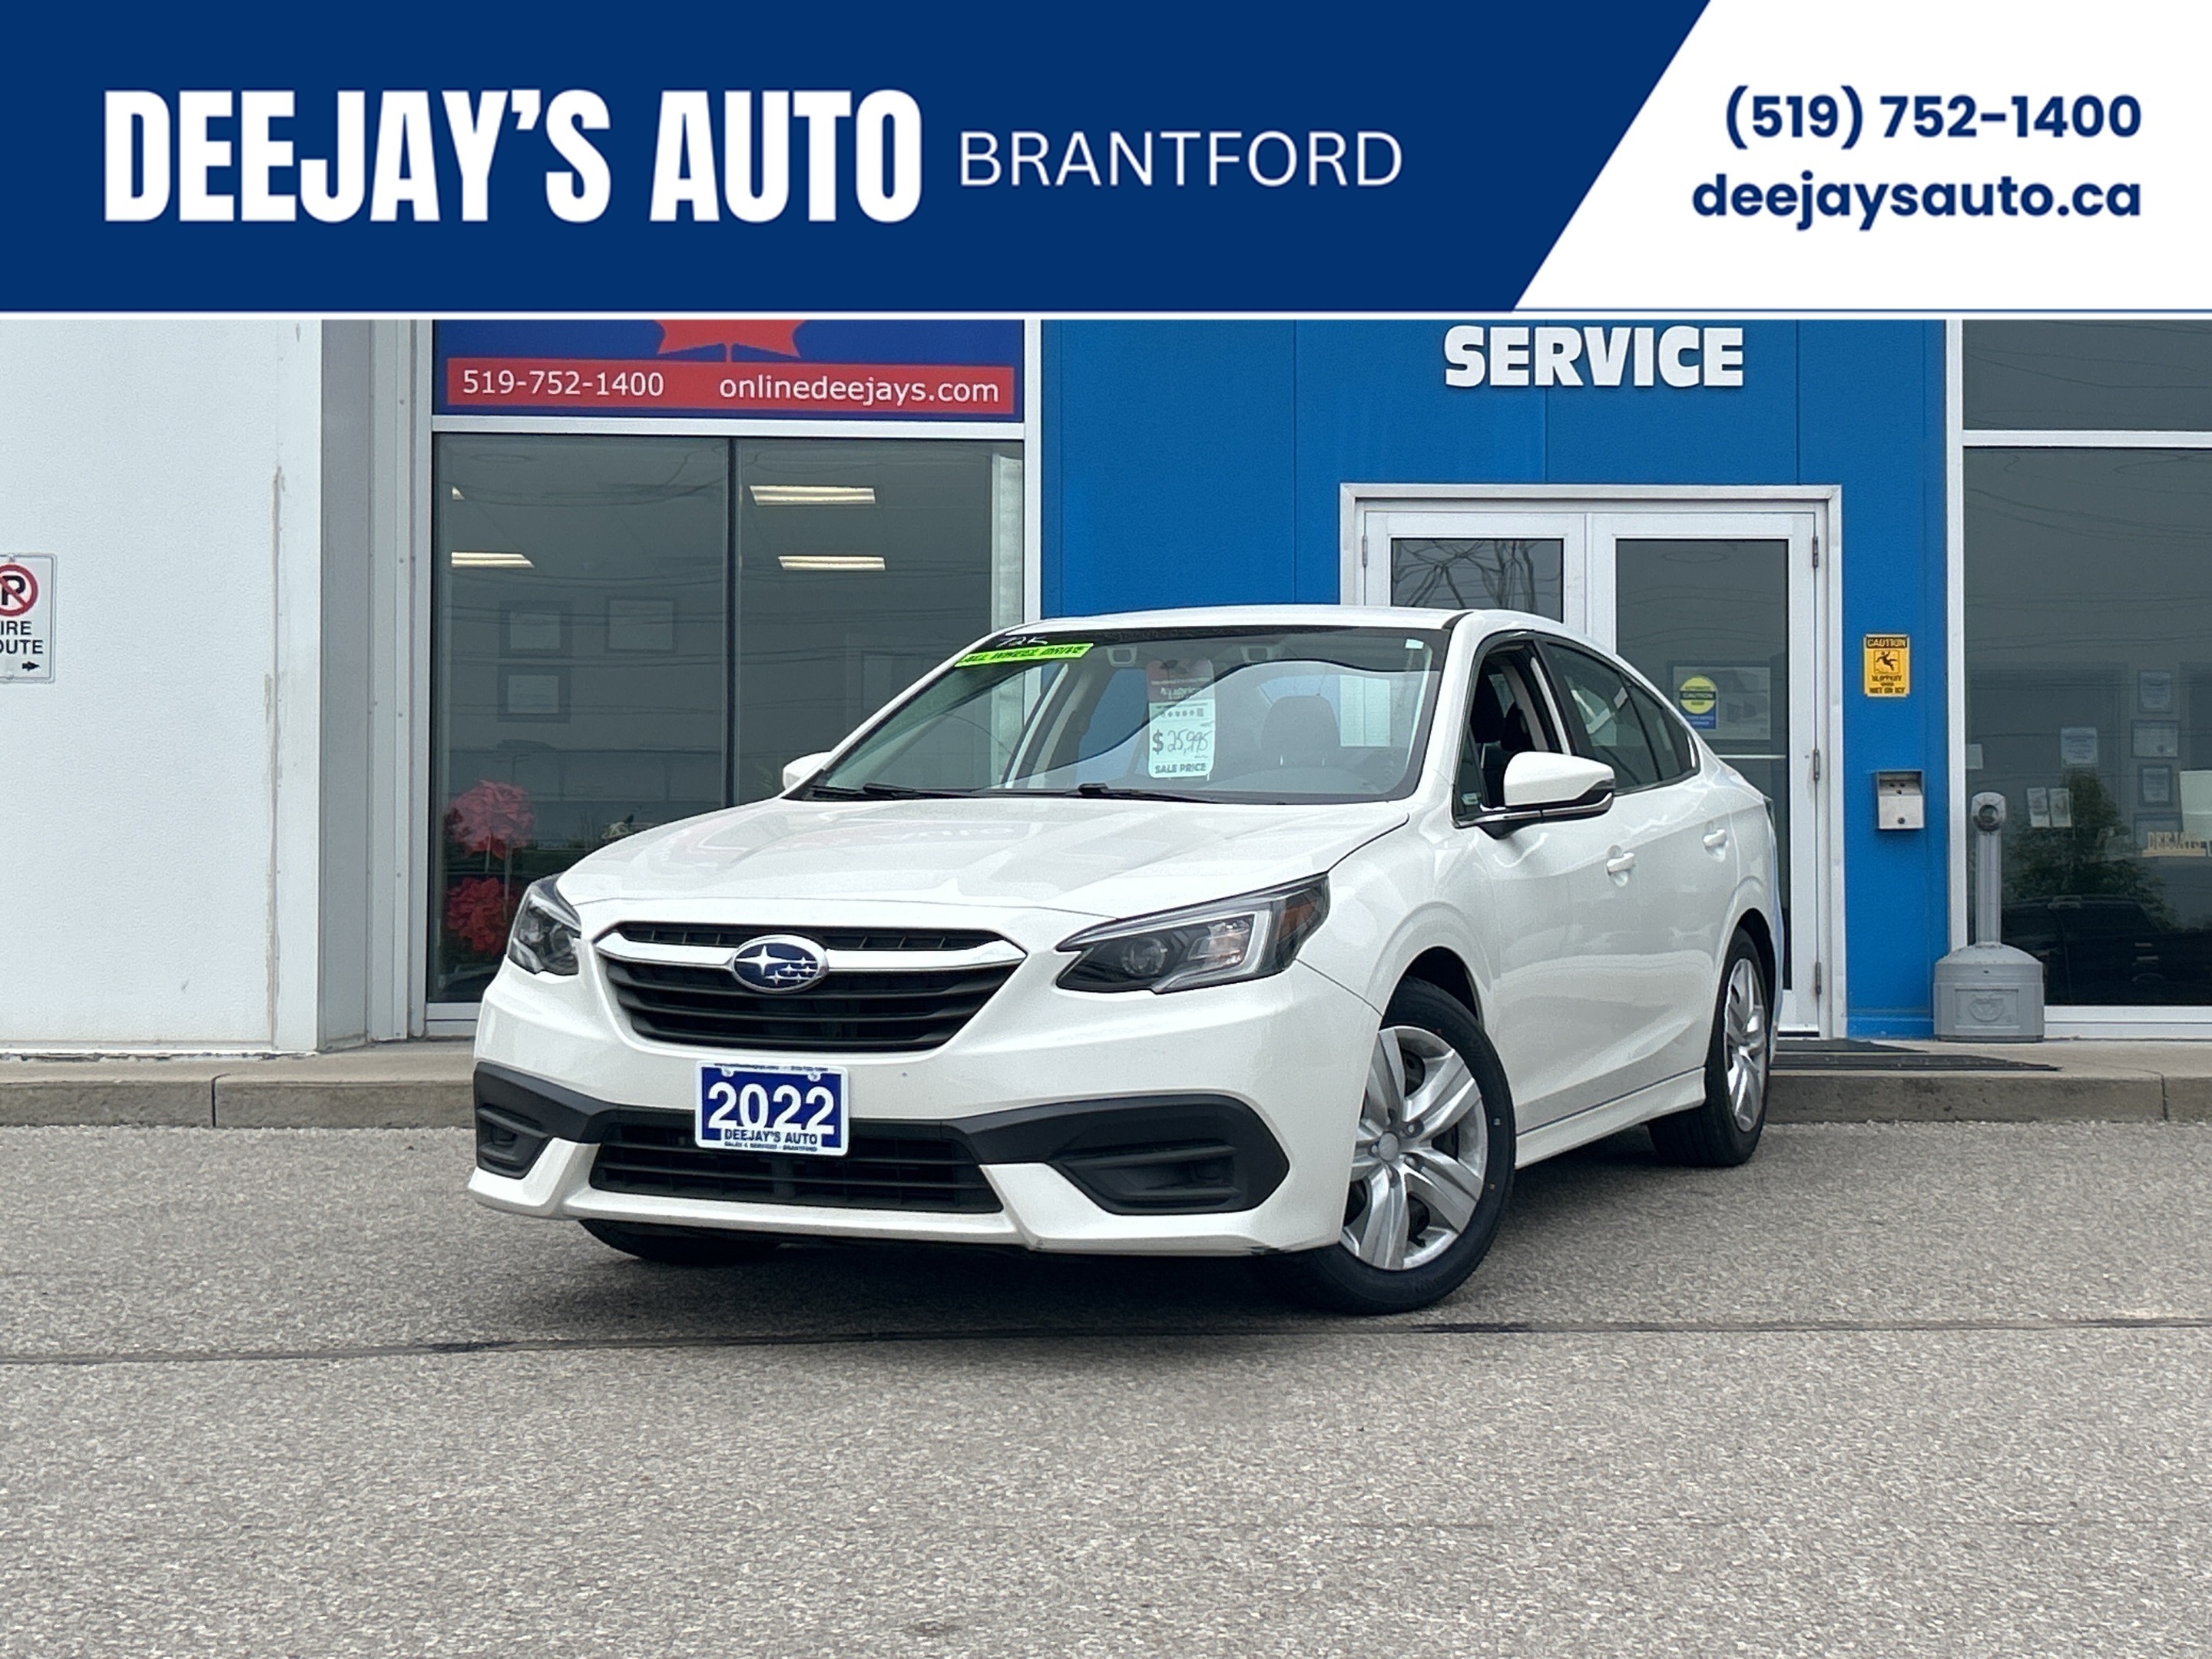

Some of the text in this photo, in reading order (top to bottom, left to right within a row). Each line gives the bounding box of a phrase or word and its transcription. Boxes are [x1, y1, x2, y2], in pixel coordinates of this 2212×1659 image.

[1444, 325, 1743, 387] SERVICE
[462, 369, 664, 397] 519-752-1400
[719, 374, 999, 407] onlinedeejays.com
[0, 620, 32, 636] IRE
[0, 639, 44, 654] UTE
[1867, 638, 1906, 647] CAUTION
[963, 645, 1089, 663] ALL WHEEL DRIVE
[1152, 730, 1164, 755] $
[1154, 763, 1207, 773] SALE PRICE
[707, 1081, 835, 1135] 2022
[724, 1128, 818, 1144] DEEJAY'S AUTO
